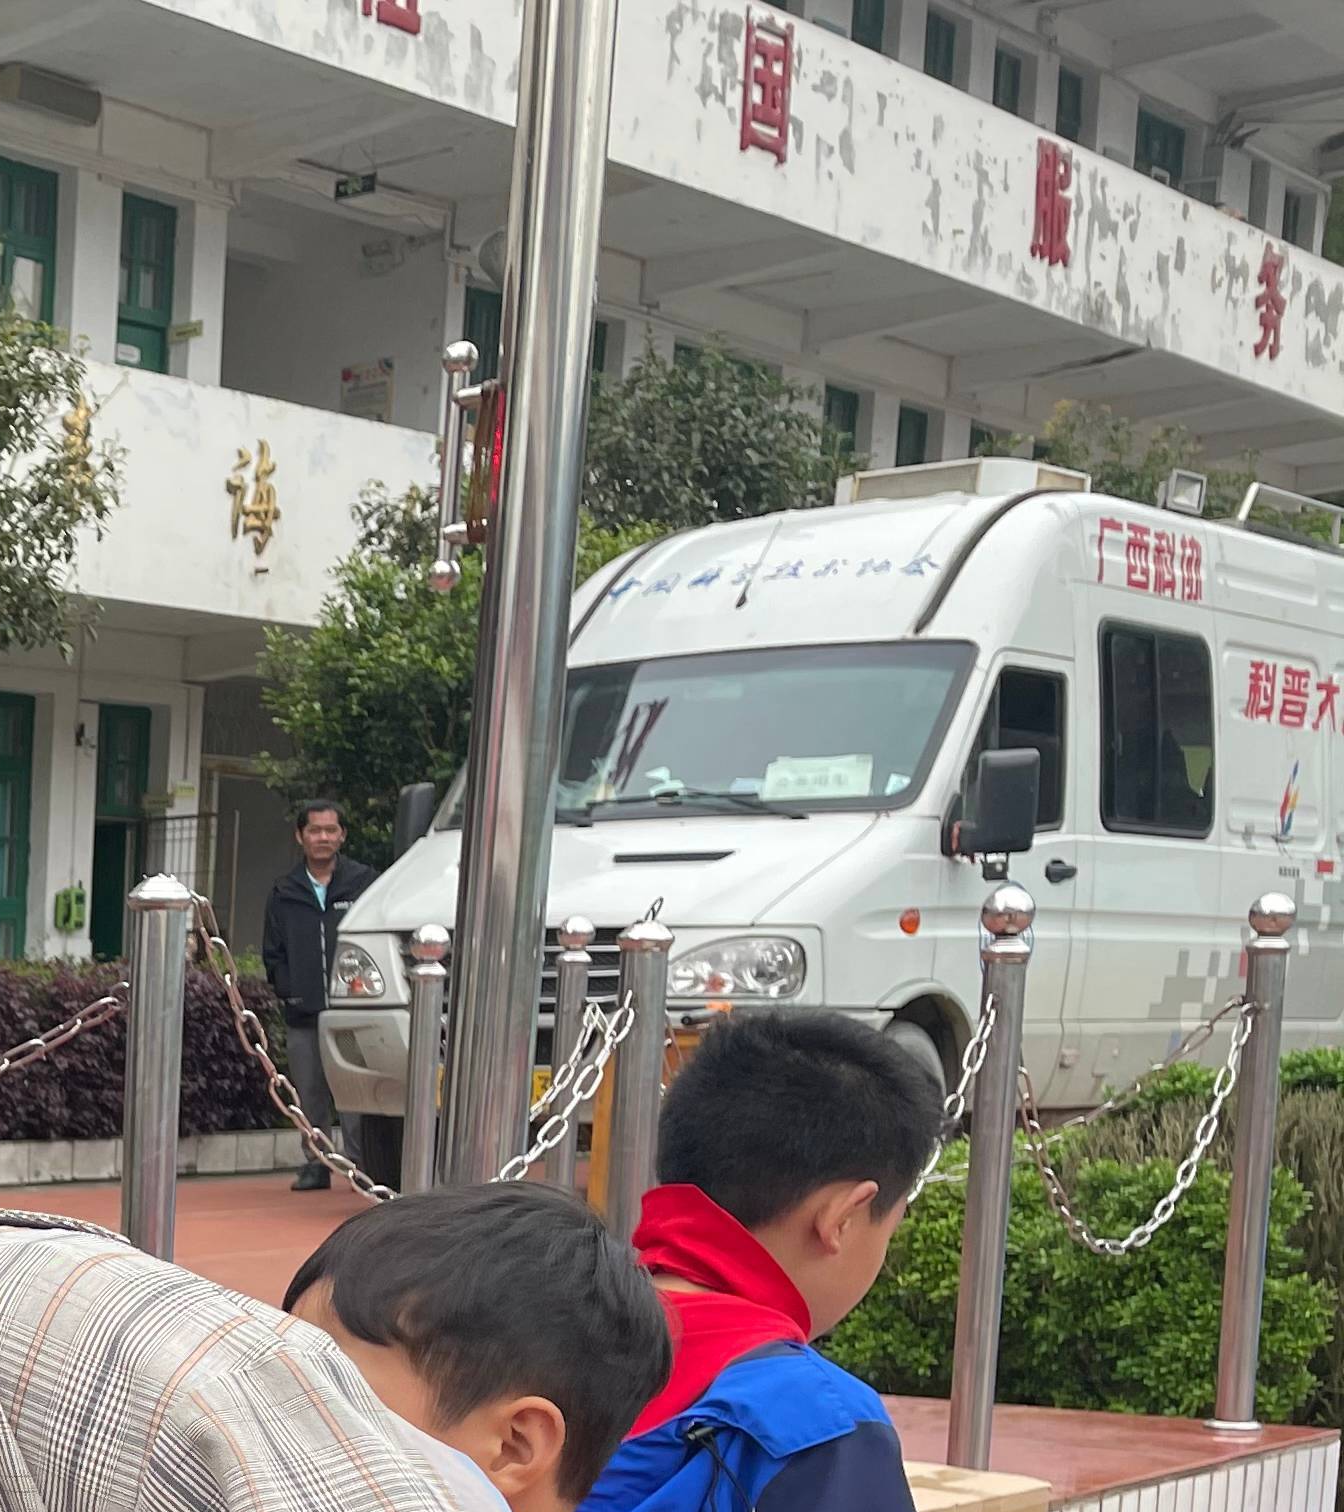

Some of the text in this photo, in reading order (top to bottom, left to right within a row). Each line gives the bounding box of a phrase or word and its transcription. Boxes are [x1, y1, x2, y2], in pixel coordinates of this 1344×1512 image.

[1097, 517, 1202, 601] 广西科协
[1243, 659, 1344, 733] 科普大
